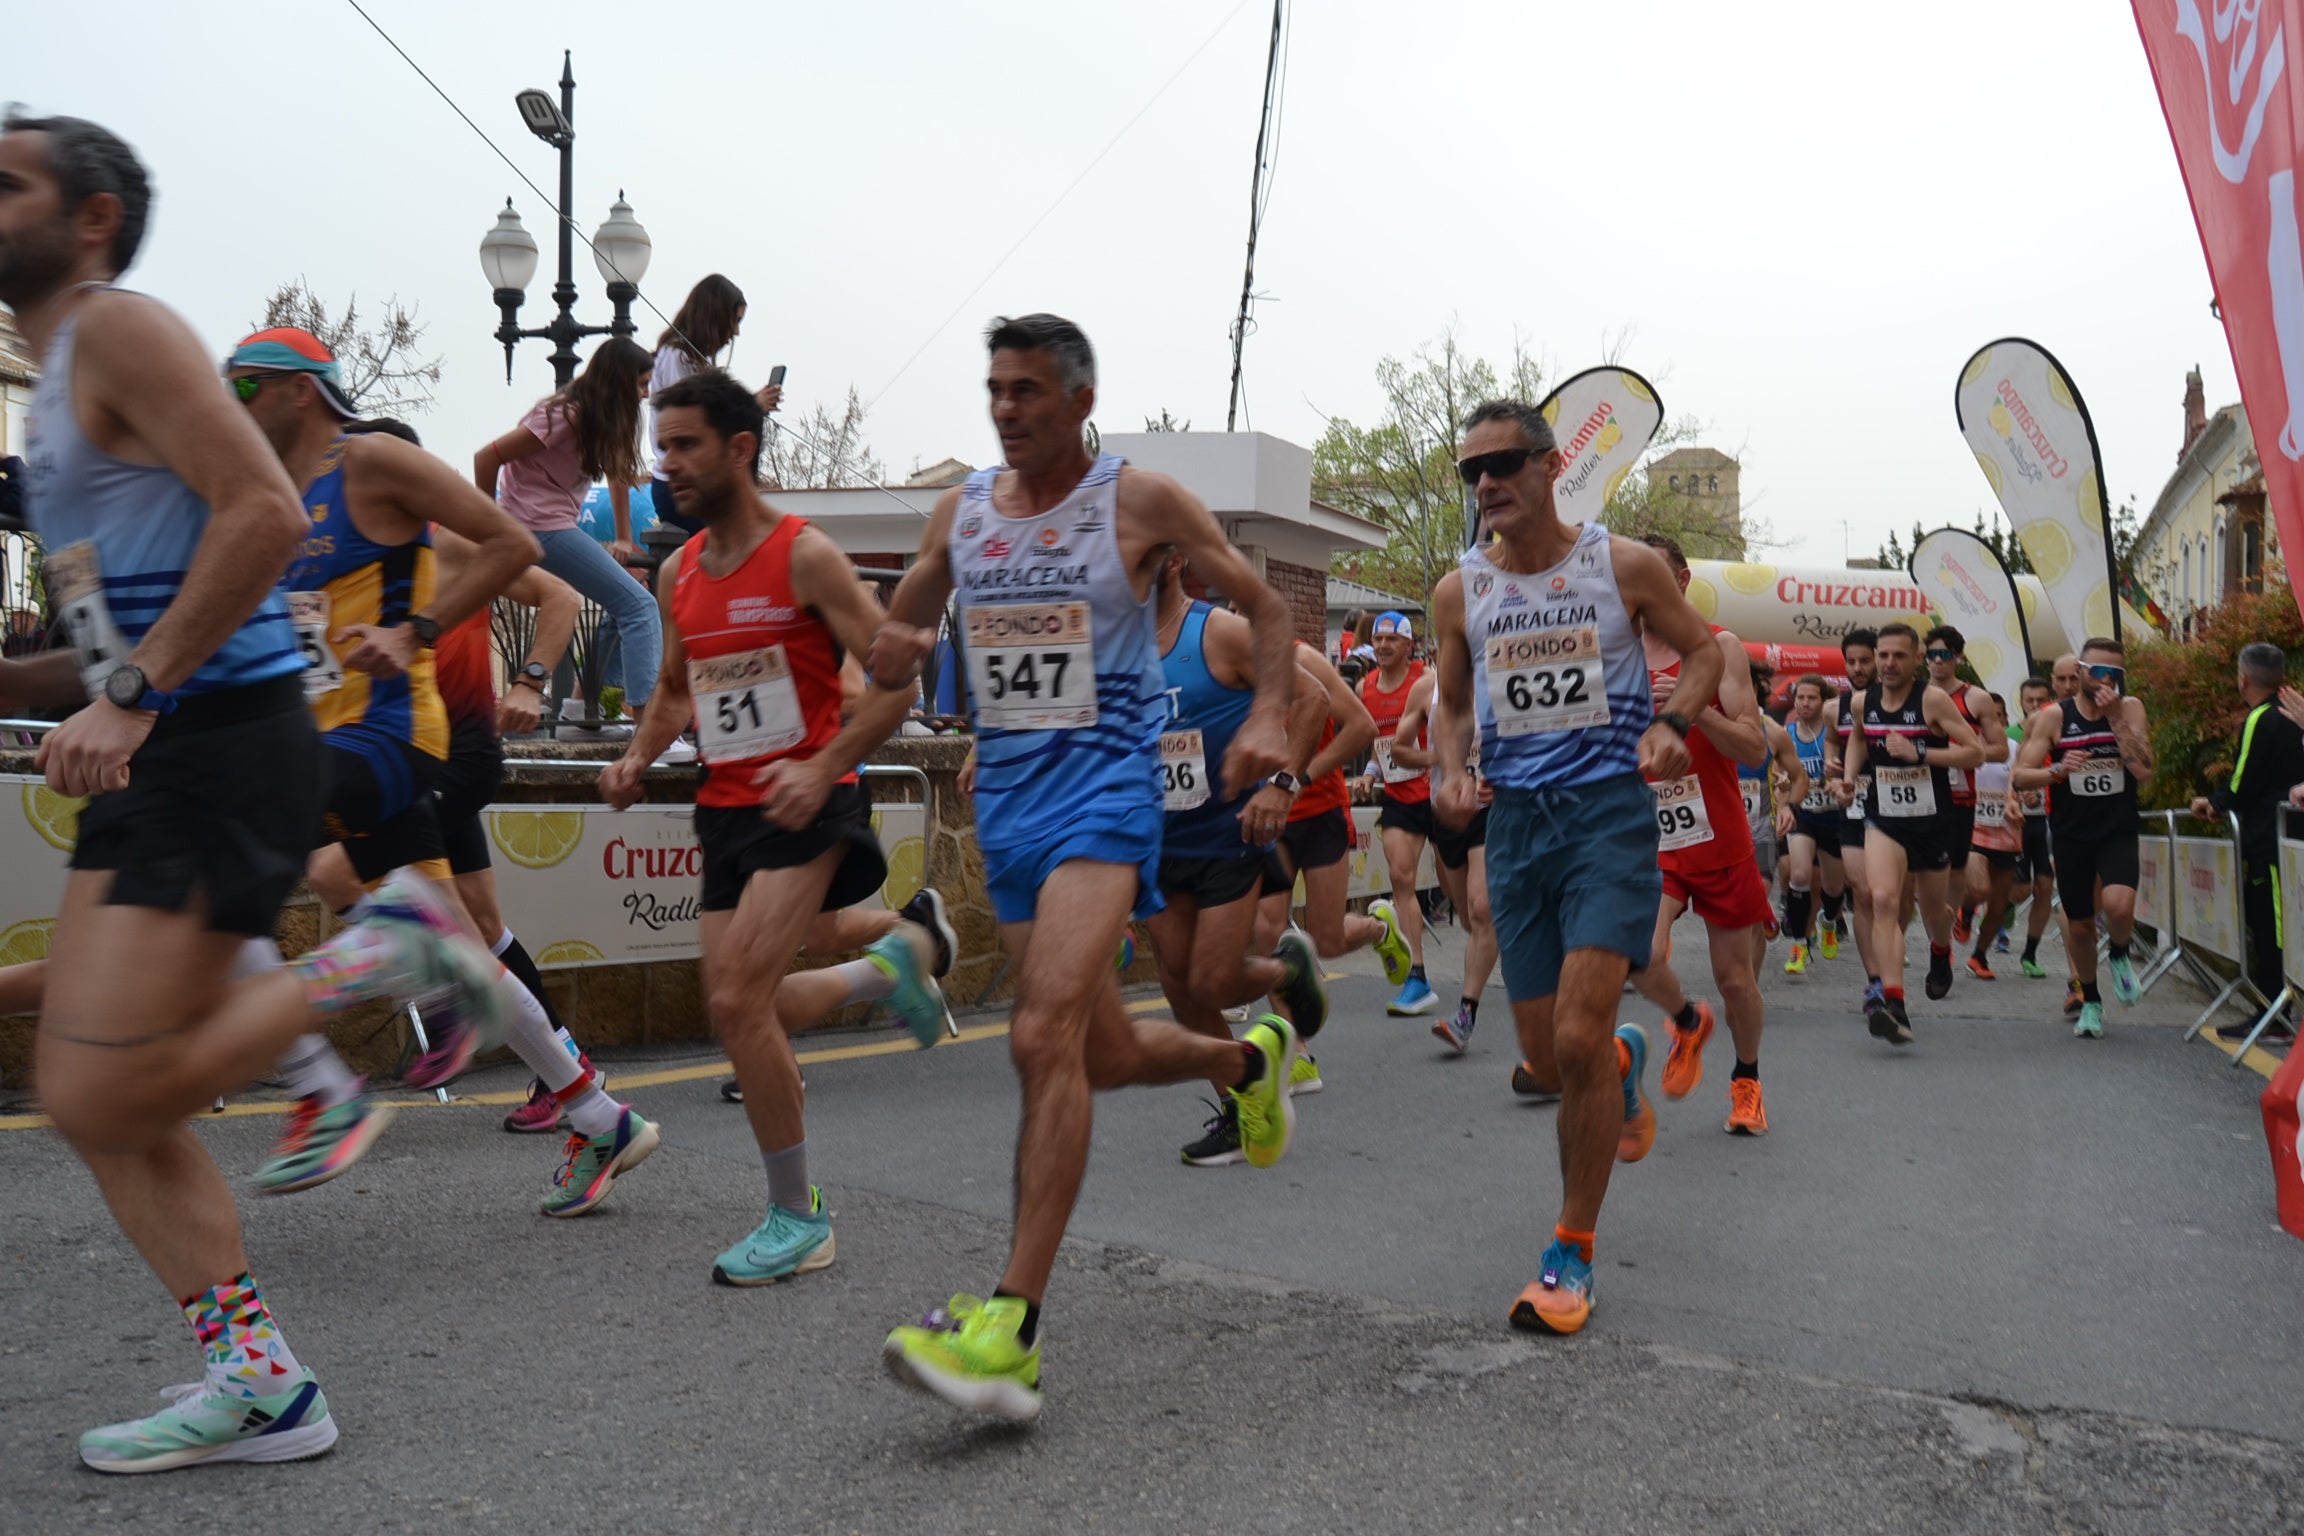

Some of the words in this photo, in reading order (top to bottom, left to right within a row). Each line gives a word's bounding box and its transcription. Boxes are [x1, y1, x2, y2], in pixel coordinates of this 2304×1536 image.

[962, 564, 1089, 590] MARACENA
[983, 614, 1063, 638] FONDO
[1487, 602, 1598, 637] MARACENA
[1506, 636, 1577, 661] FONDO
[985, 651, 1071, 701] 547
[1506, 667, 1590, 712] 632
[716, 688, 763, 735] 51
[1884, 771, 1919, 782] FONDO
[2083, 774, 2112, 793] 66
[1890, 786, 1918, 804] 58
